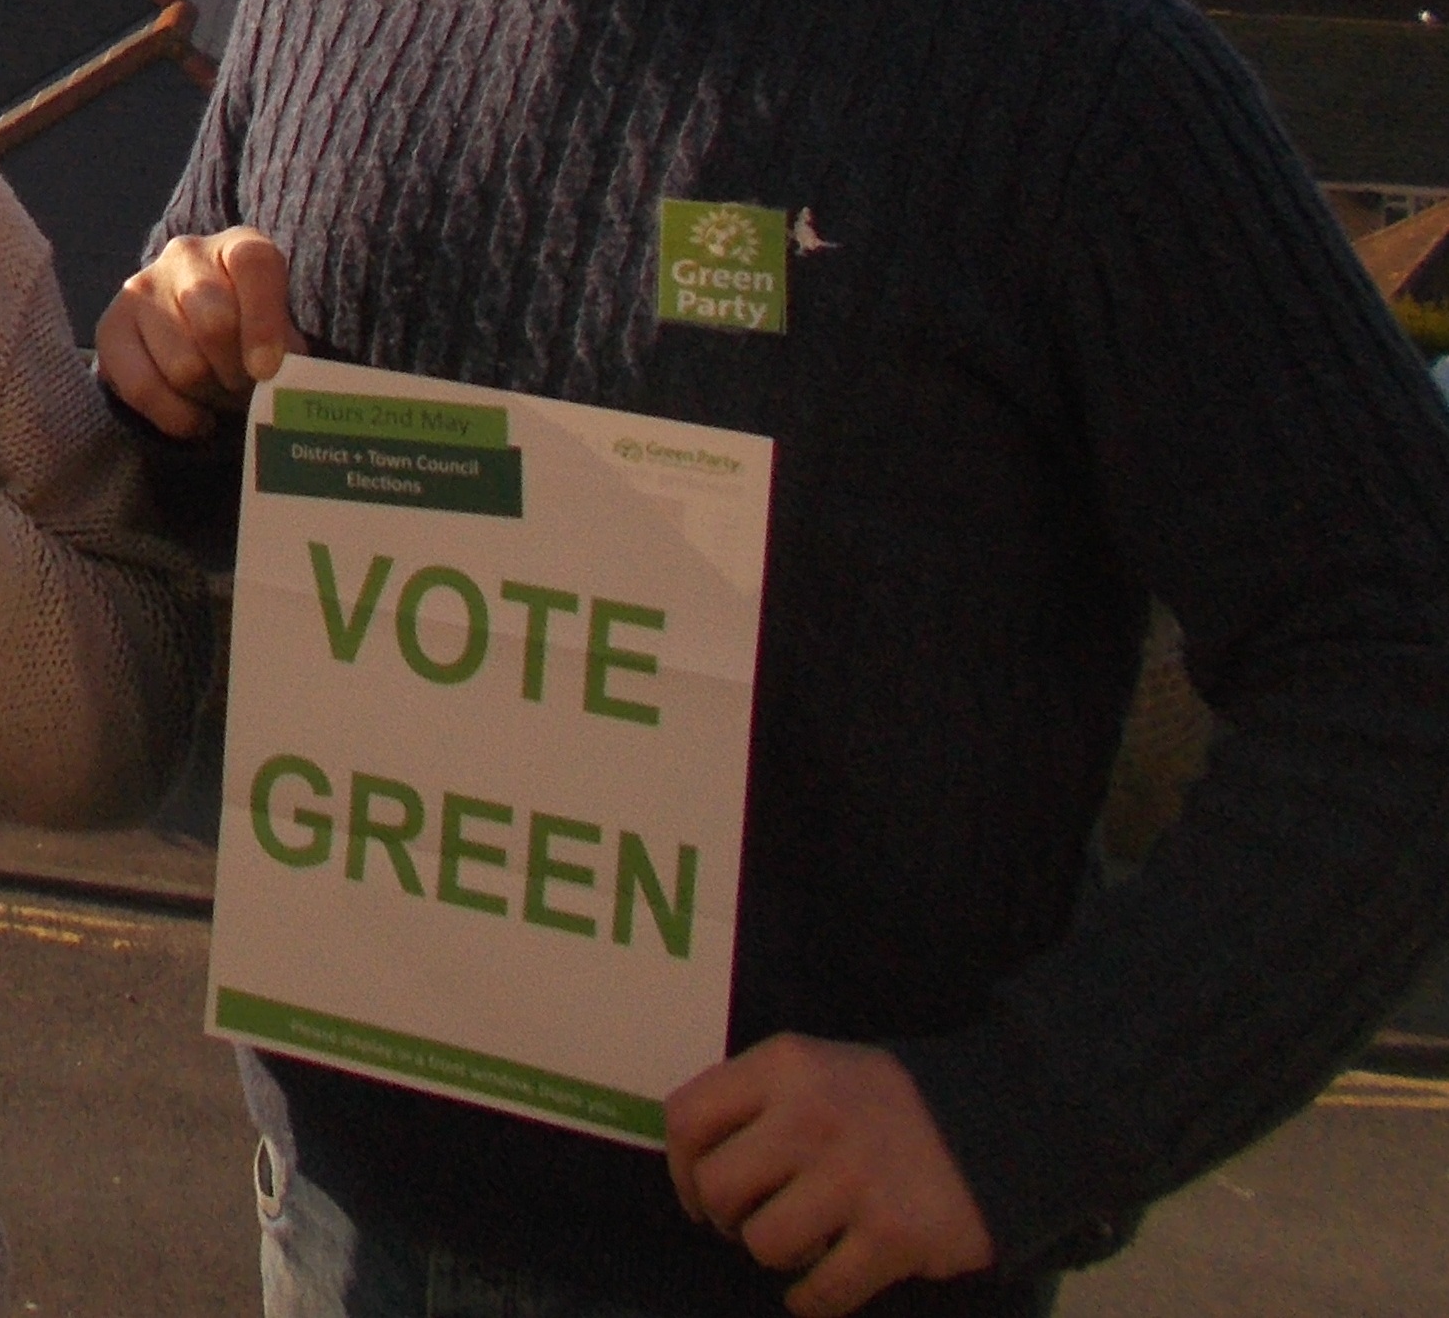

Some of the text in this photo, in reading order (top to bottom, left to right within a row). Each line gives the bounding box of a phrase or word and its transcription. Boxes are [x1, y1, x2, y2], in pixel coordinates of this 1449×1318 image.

[670, 258, 776, 293] Green
[676, 288, 770, 330] Party
[304, 400, 471, 436] Thurs 2nd May
[291, 443, 480, 477] District + Town Council
[346, 470, 423, 494] Elections
[306, 540, 668, 728] VOTE
[248, 752, 701, 962] GREEN
